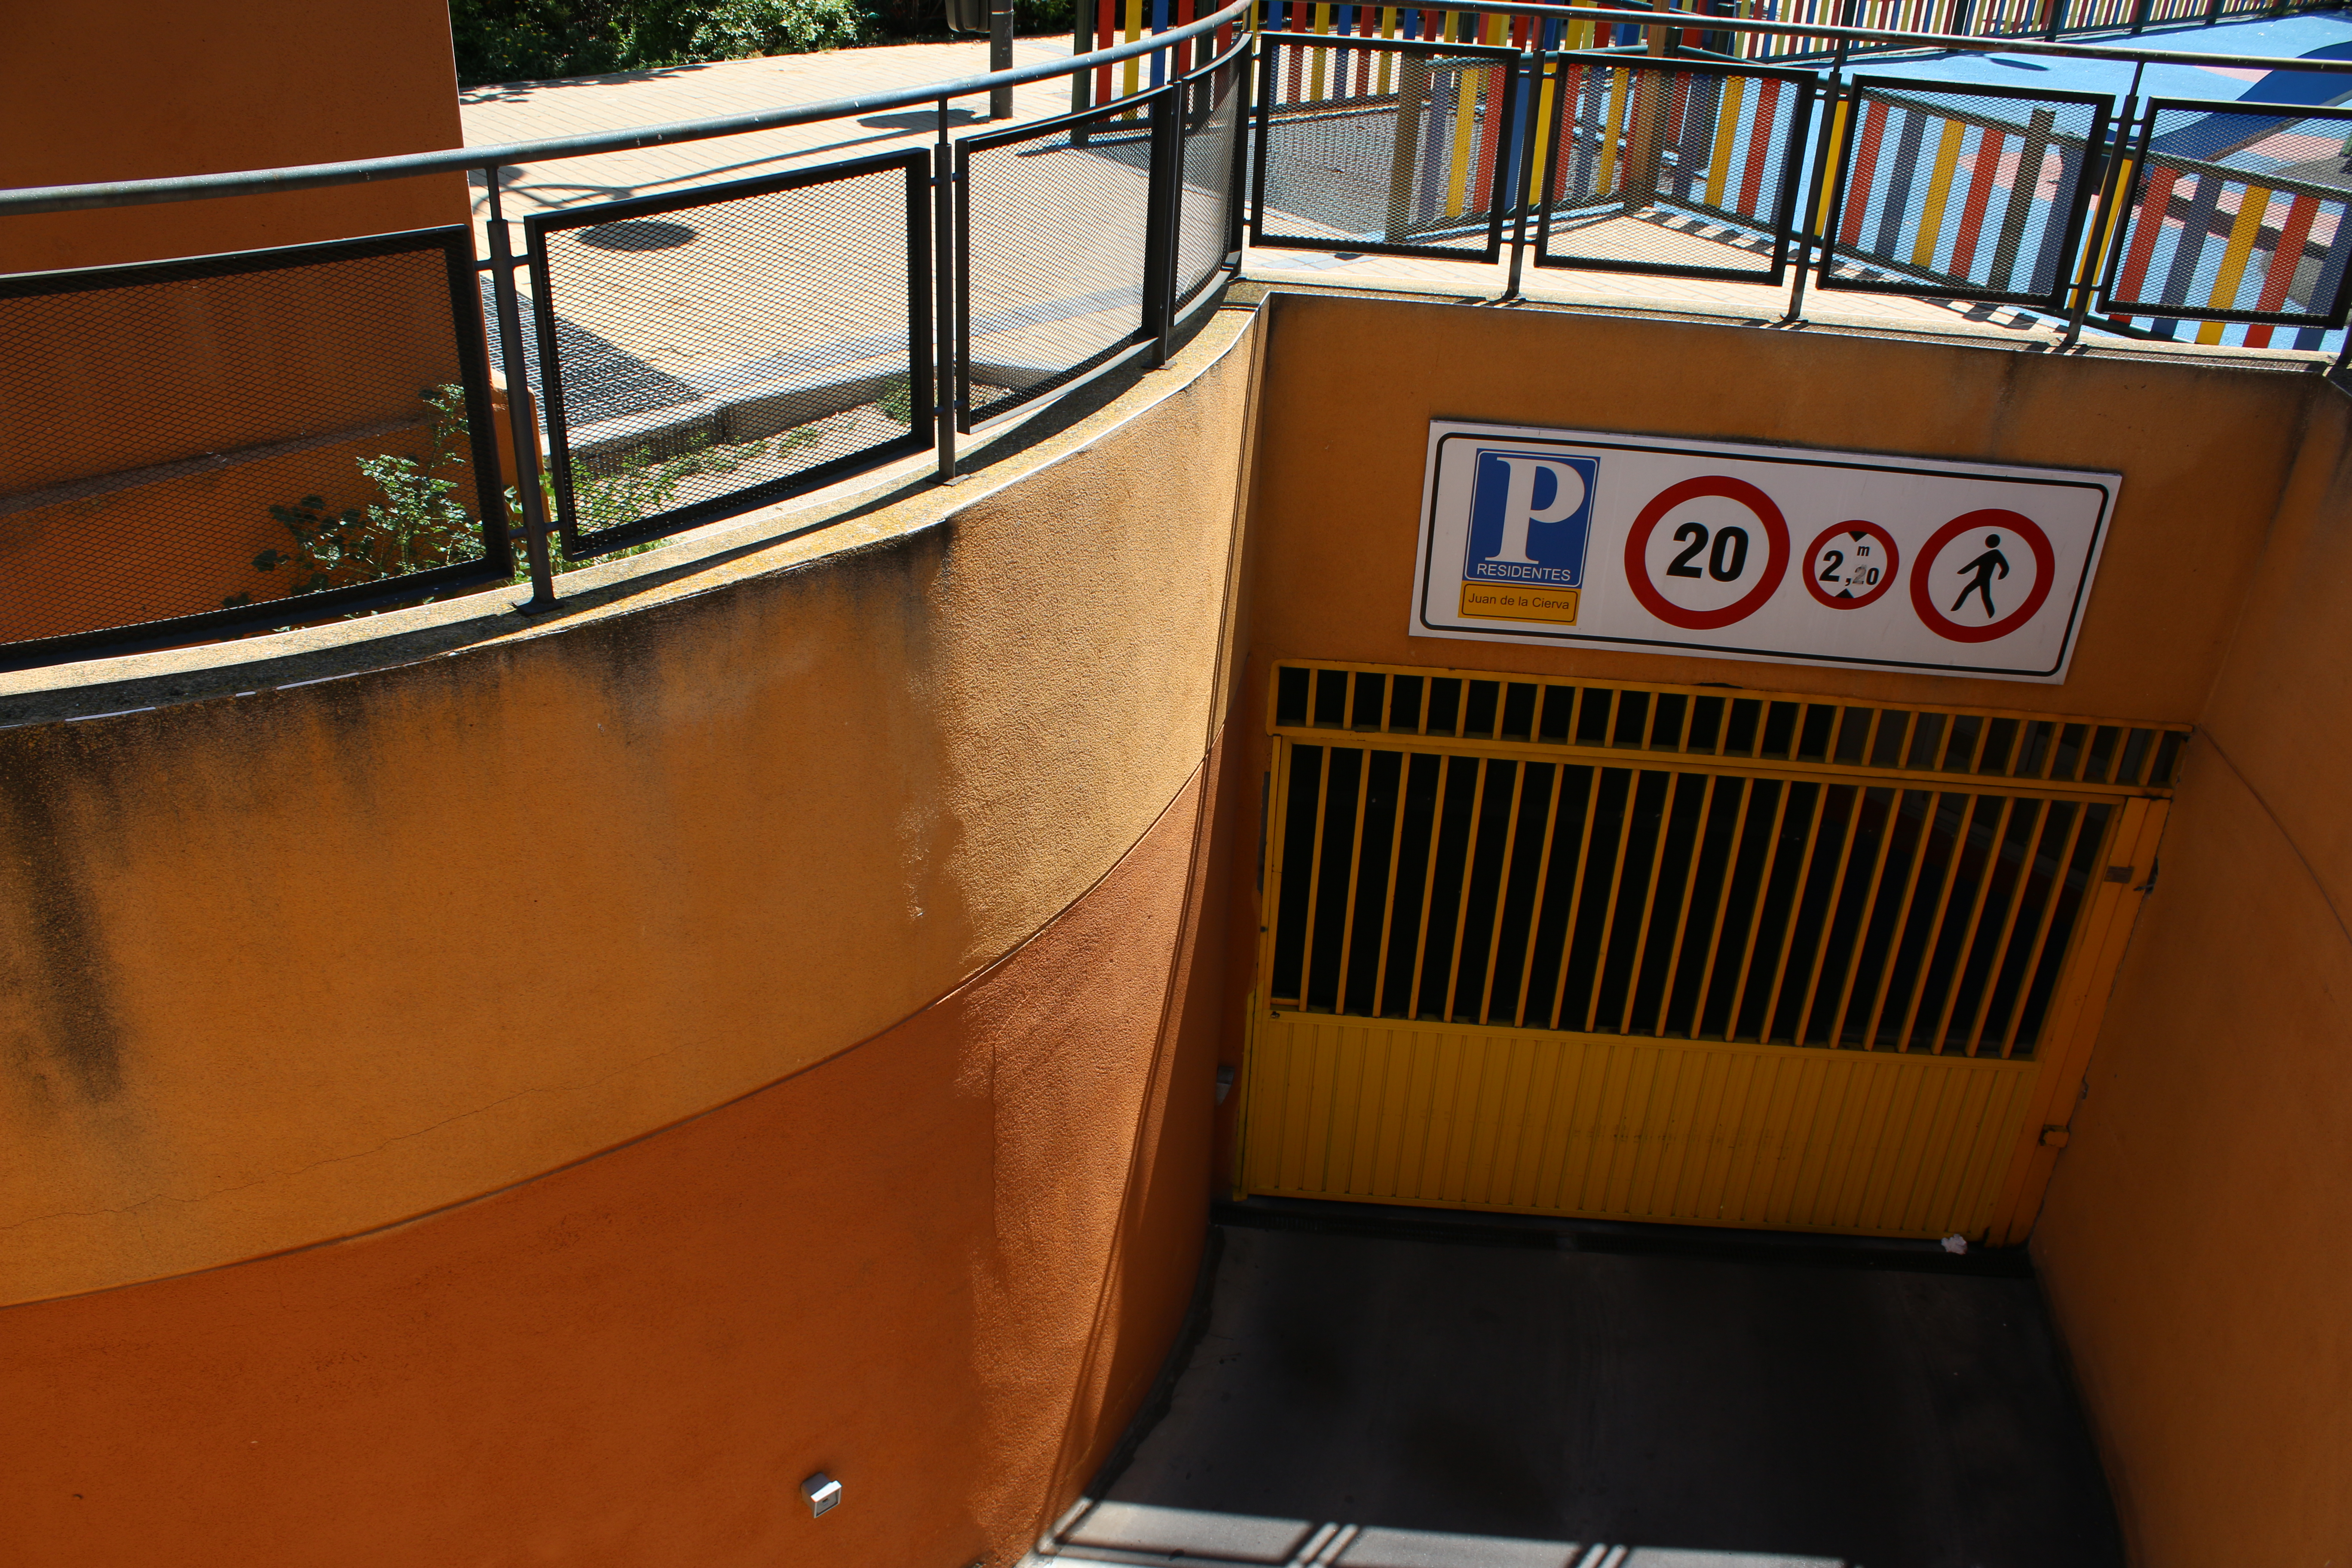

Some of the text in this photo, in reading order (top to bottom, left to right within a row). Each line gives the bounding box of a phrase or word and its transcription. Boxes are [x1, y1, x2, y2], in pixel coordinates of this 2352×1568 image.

[1485, 457, 1585, 564] P
[1666, 522, 1749, 582] 20
[1856, 545, 1870, 557] m
[1477, 563, 1571, 581] RESIDENTES
[1468, 593, 1569, 609] Juan de la Cierva
